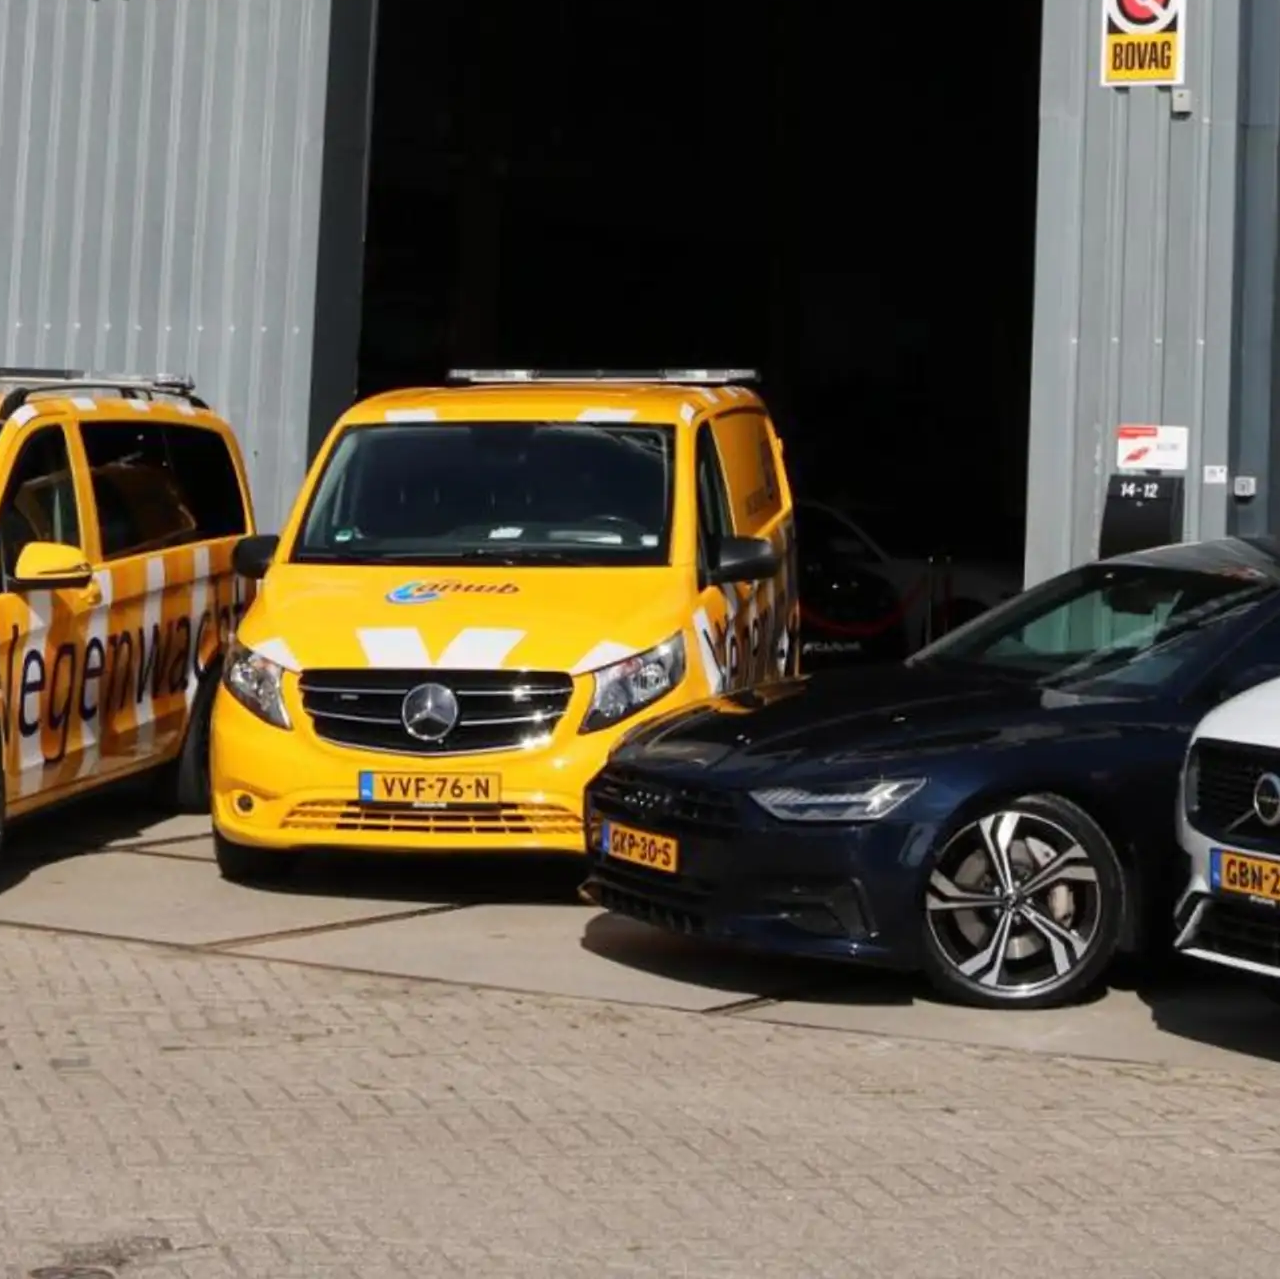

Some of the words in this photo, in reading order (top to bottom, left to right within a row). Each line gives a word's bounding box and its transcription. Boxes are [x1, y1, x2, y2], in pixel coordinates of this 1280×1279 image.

[1112, 41, 1172, 71] BOVAG
[1120, 481, 1159, 499] 14-12
[382, 776, 490, 799] VVF-76-N
[611, 828, 672, 867] GKP-30-S
